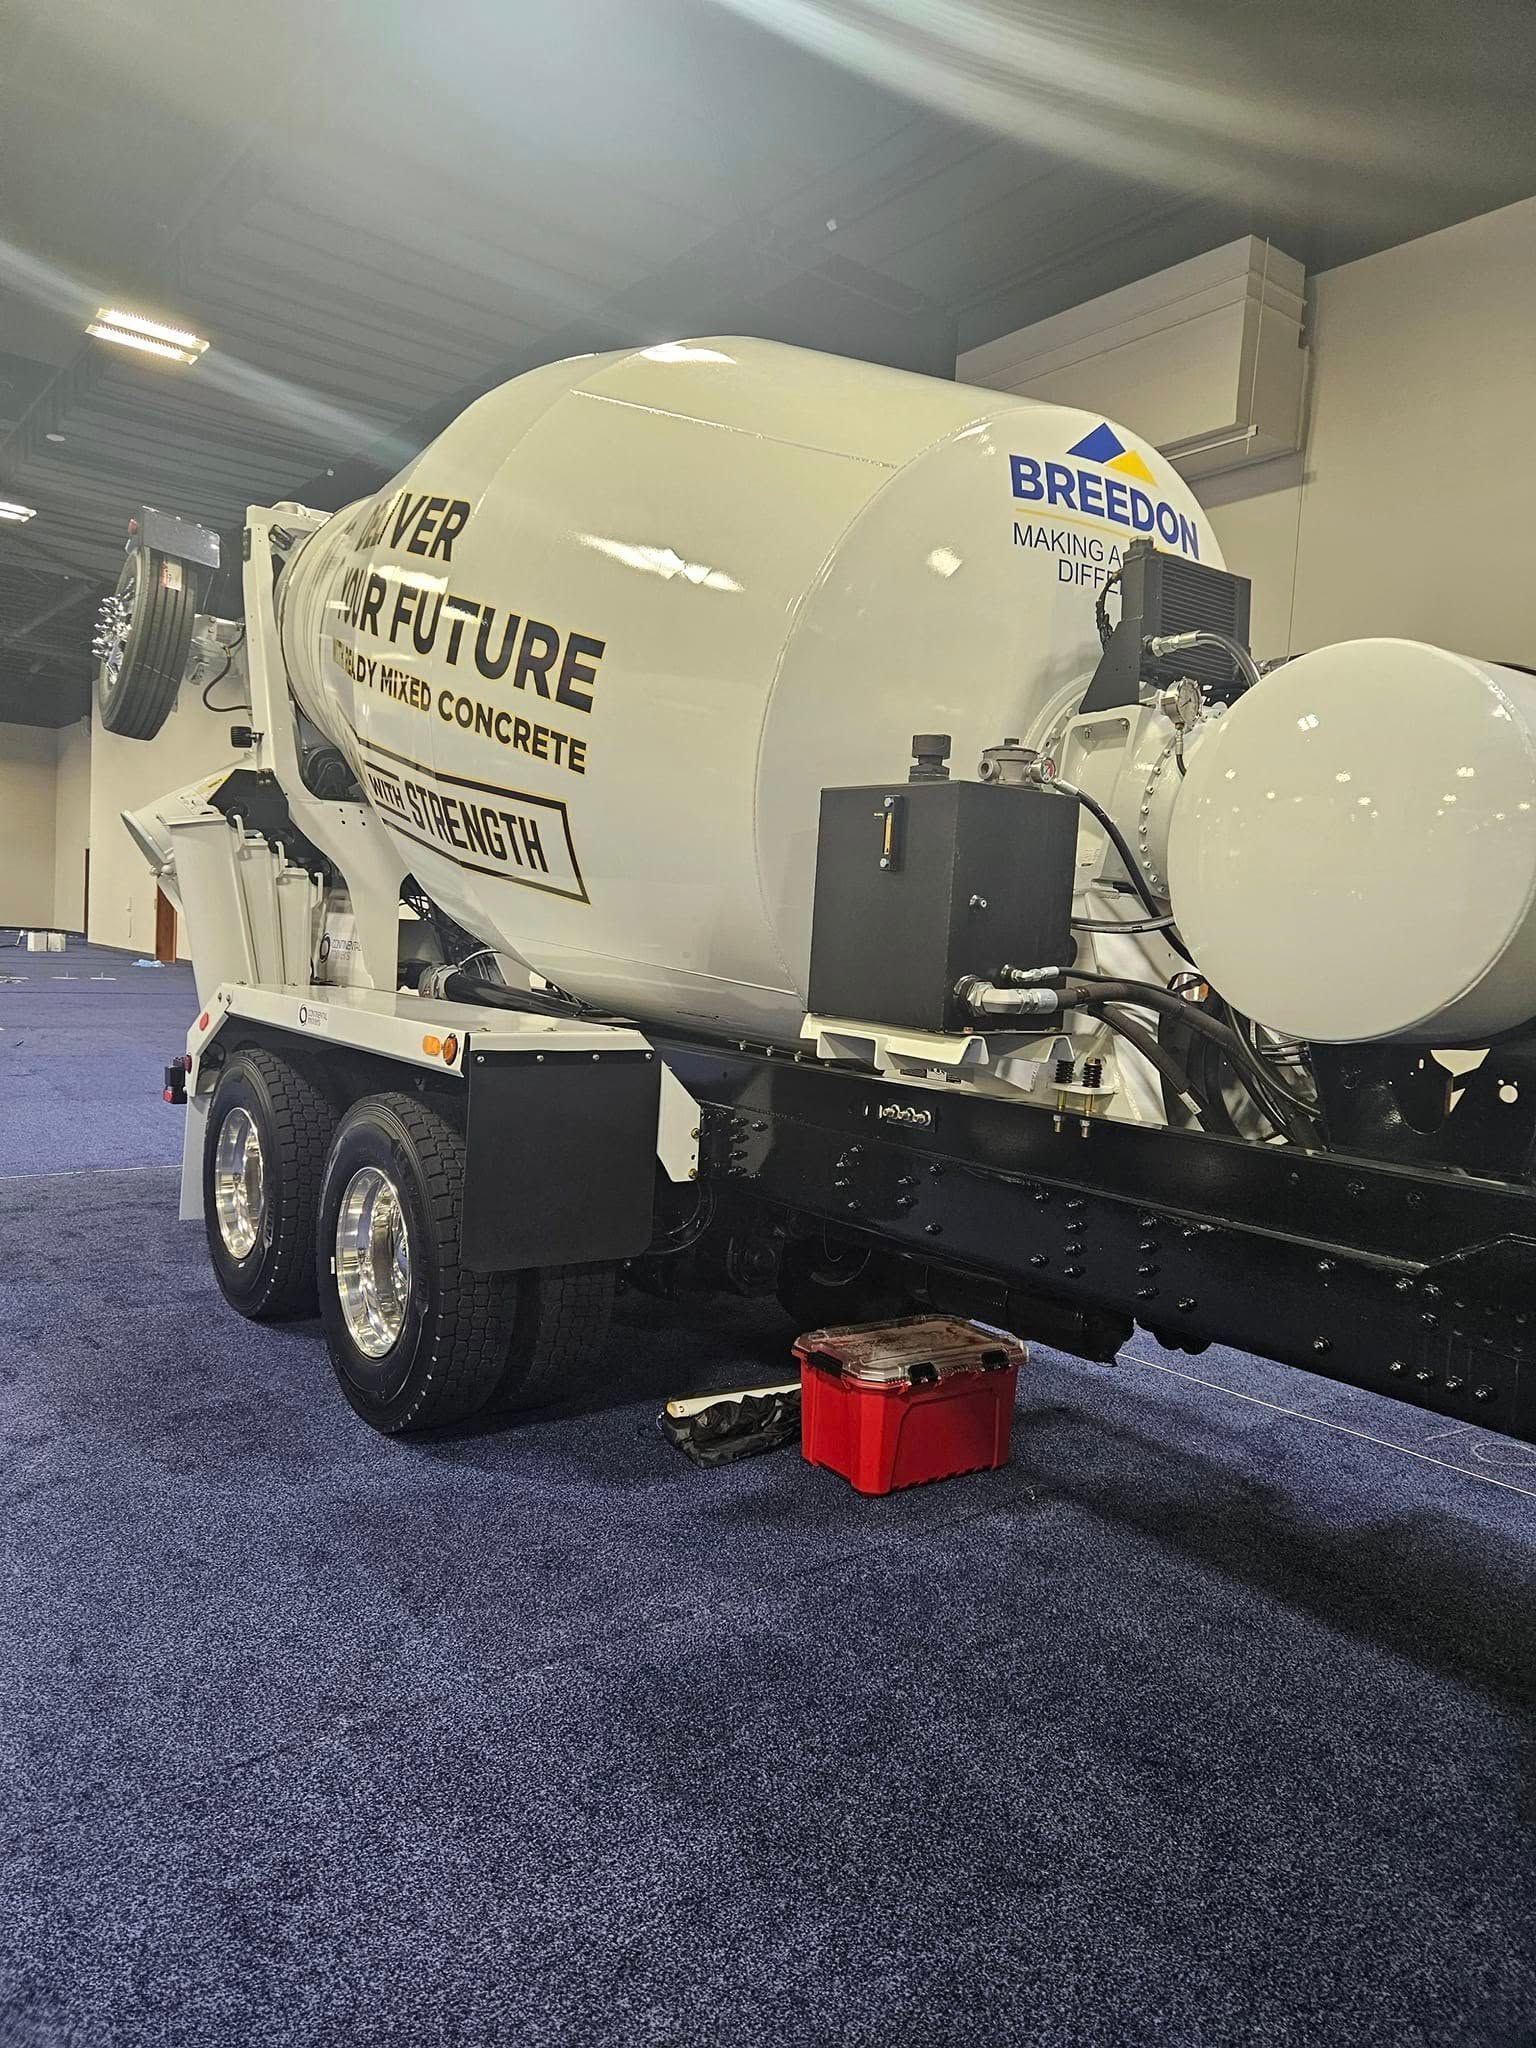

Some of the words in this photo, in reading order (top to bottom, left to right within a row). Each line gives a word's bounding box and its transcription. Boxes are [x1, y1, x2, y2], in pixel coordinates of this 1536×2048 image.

[1009, 454, 1199, 560] BREEDON
[1013, 522, 1104, 562] MAKING
[1108, 545, 1122, 568] A
[1058, 559, 1122, 595] DIFFE
[389, 582, 606, 713] FUTURE
[380, 665, 431, 712] MIXED
[438, 690, 587, 775] CONCRETE
[368, 774, 405, 811] WITH
[404, 780, 550, 873] STRENGTH
